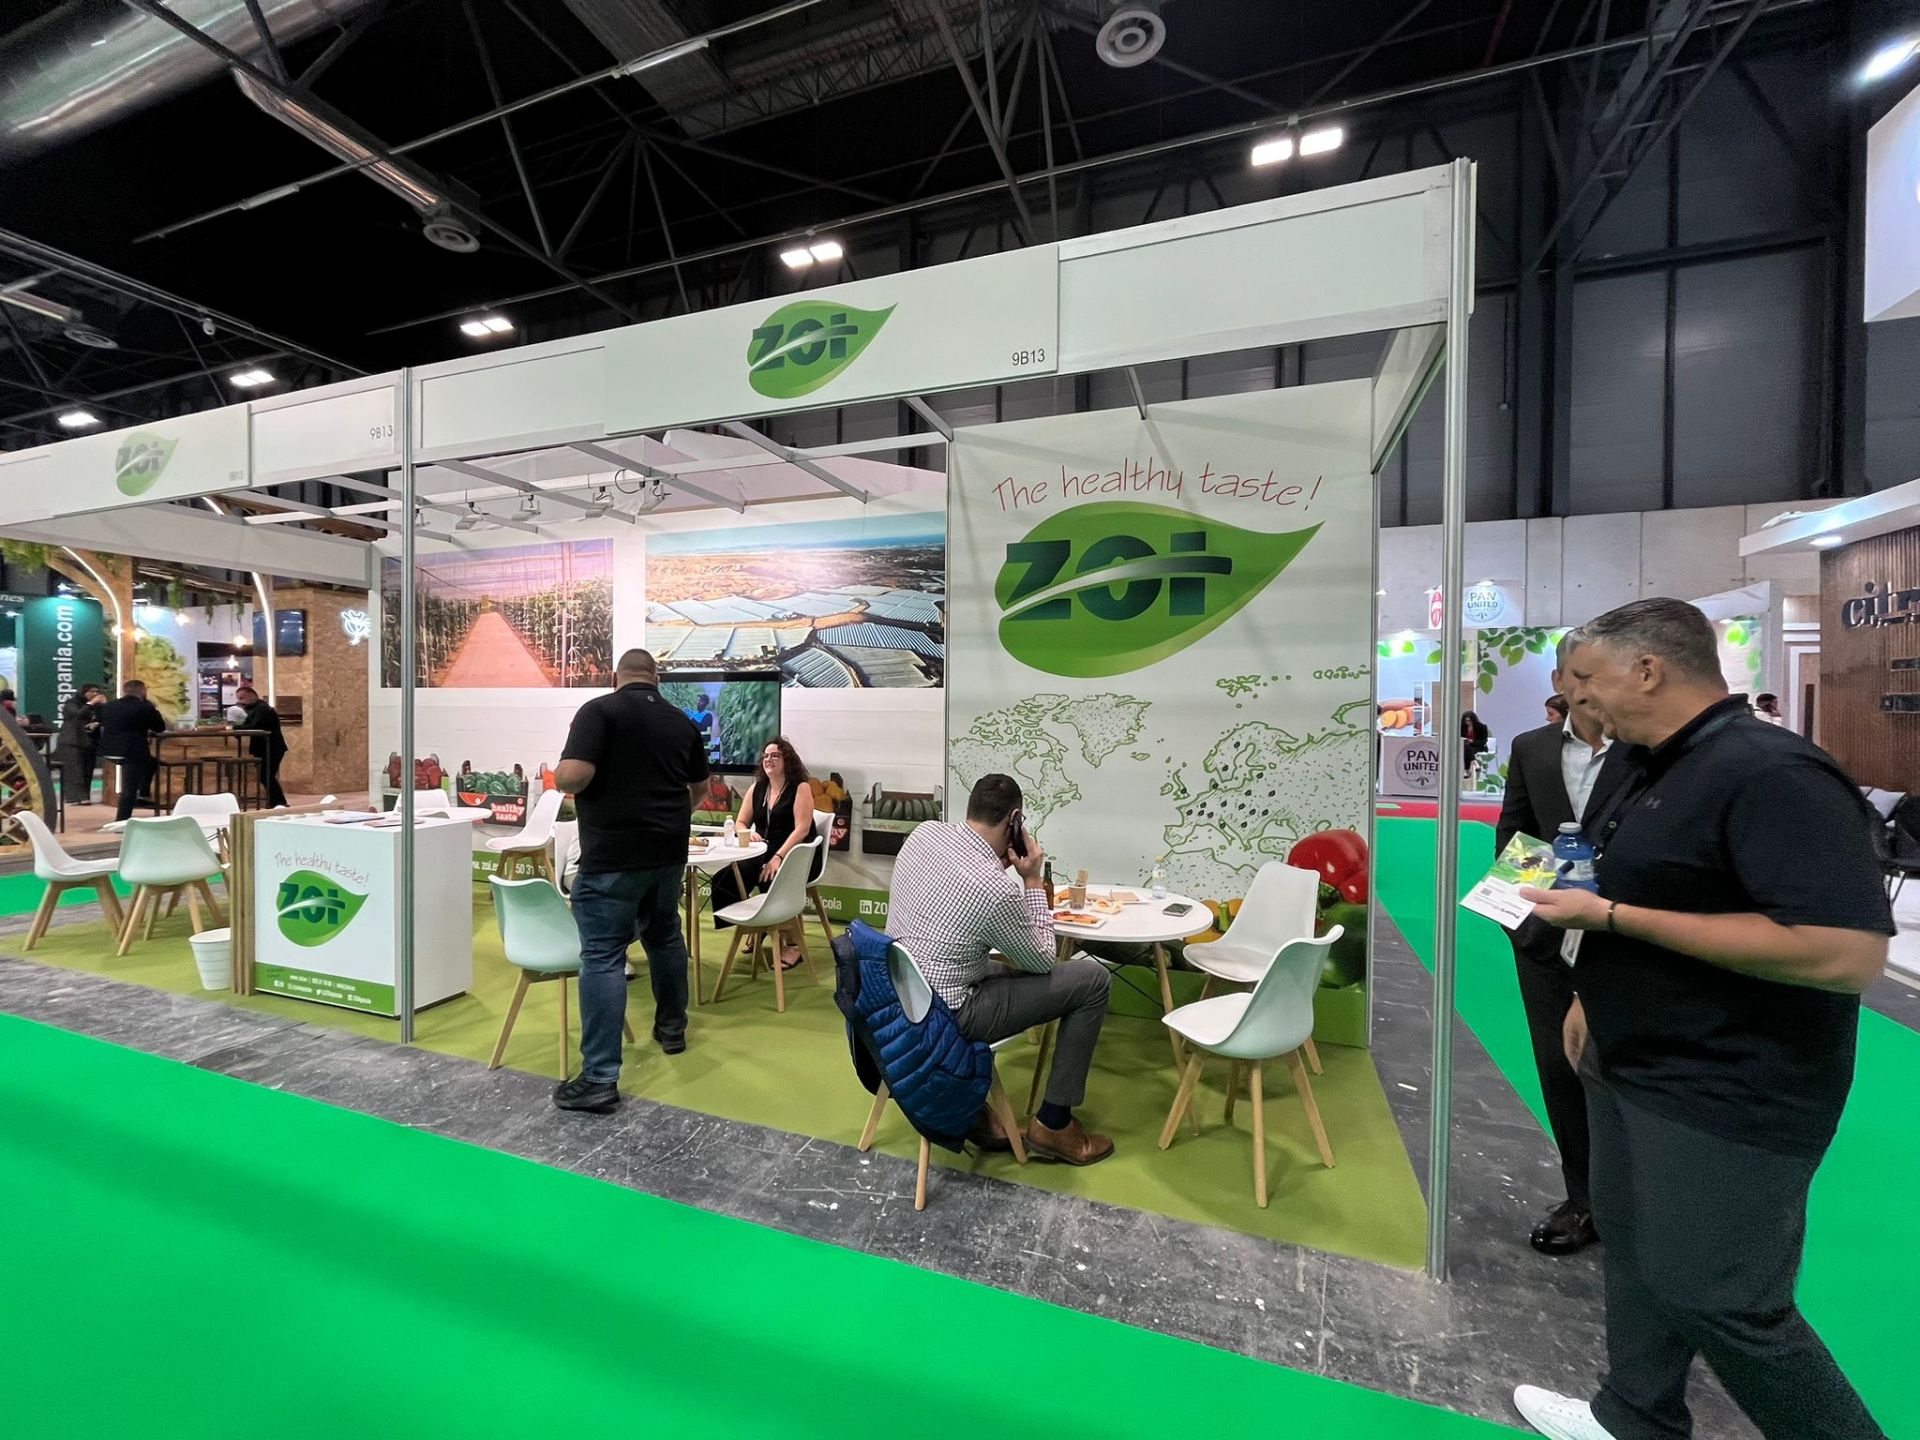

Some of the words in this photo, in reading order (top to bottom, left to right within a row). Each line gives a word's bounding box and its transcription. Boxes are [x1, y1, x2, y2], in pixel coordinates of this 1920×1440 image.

[1012, 349, 1045, 366] 9B13
[370, 424, 394, 440] 9B13
[992, 477, 1048, 511] The
[1061, 457, 1184, 500] healthy
[1199, 462, 1322, 511] taste!
[1470, 591, 1497, 601] PAN
[1467, 601, 1499, 609] UNITED
[1406, 750, 1440, 762] PAN
[491, 802, 525, 817] healthy
[495, 812, 517, 821] taste
[275, 852, 293, 868] The
[295, 851, 332, 873] healthy
[335, 861, 369, 888] taste!
